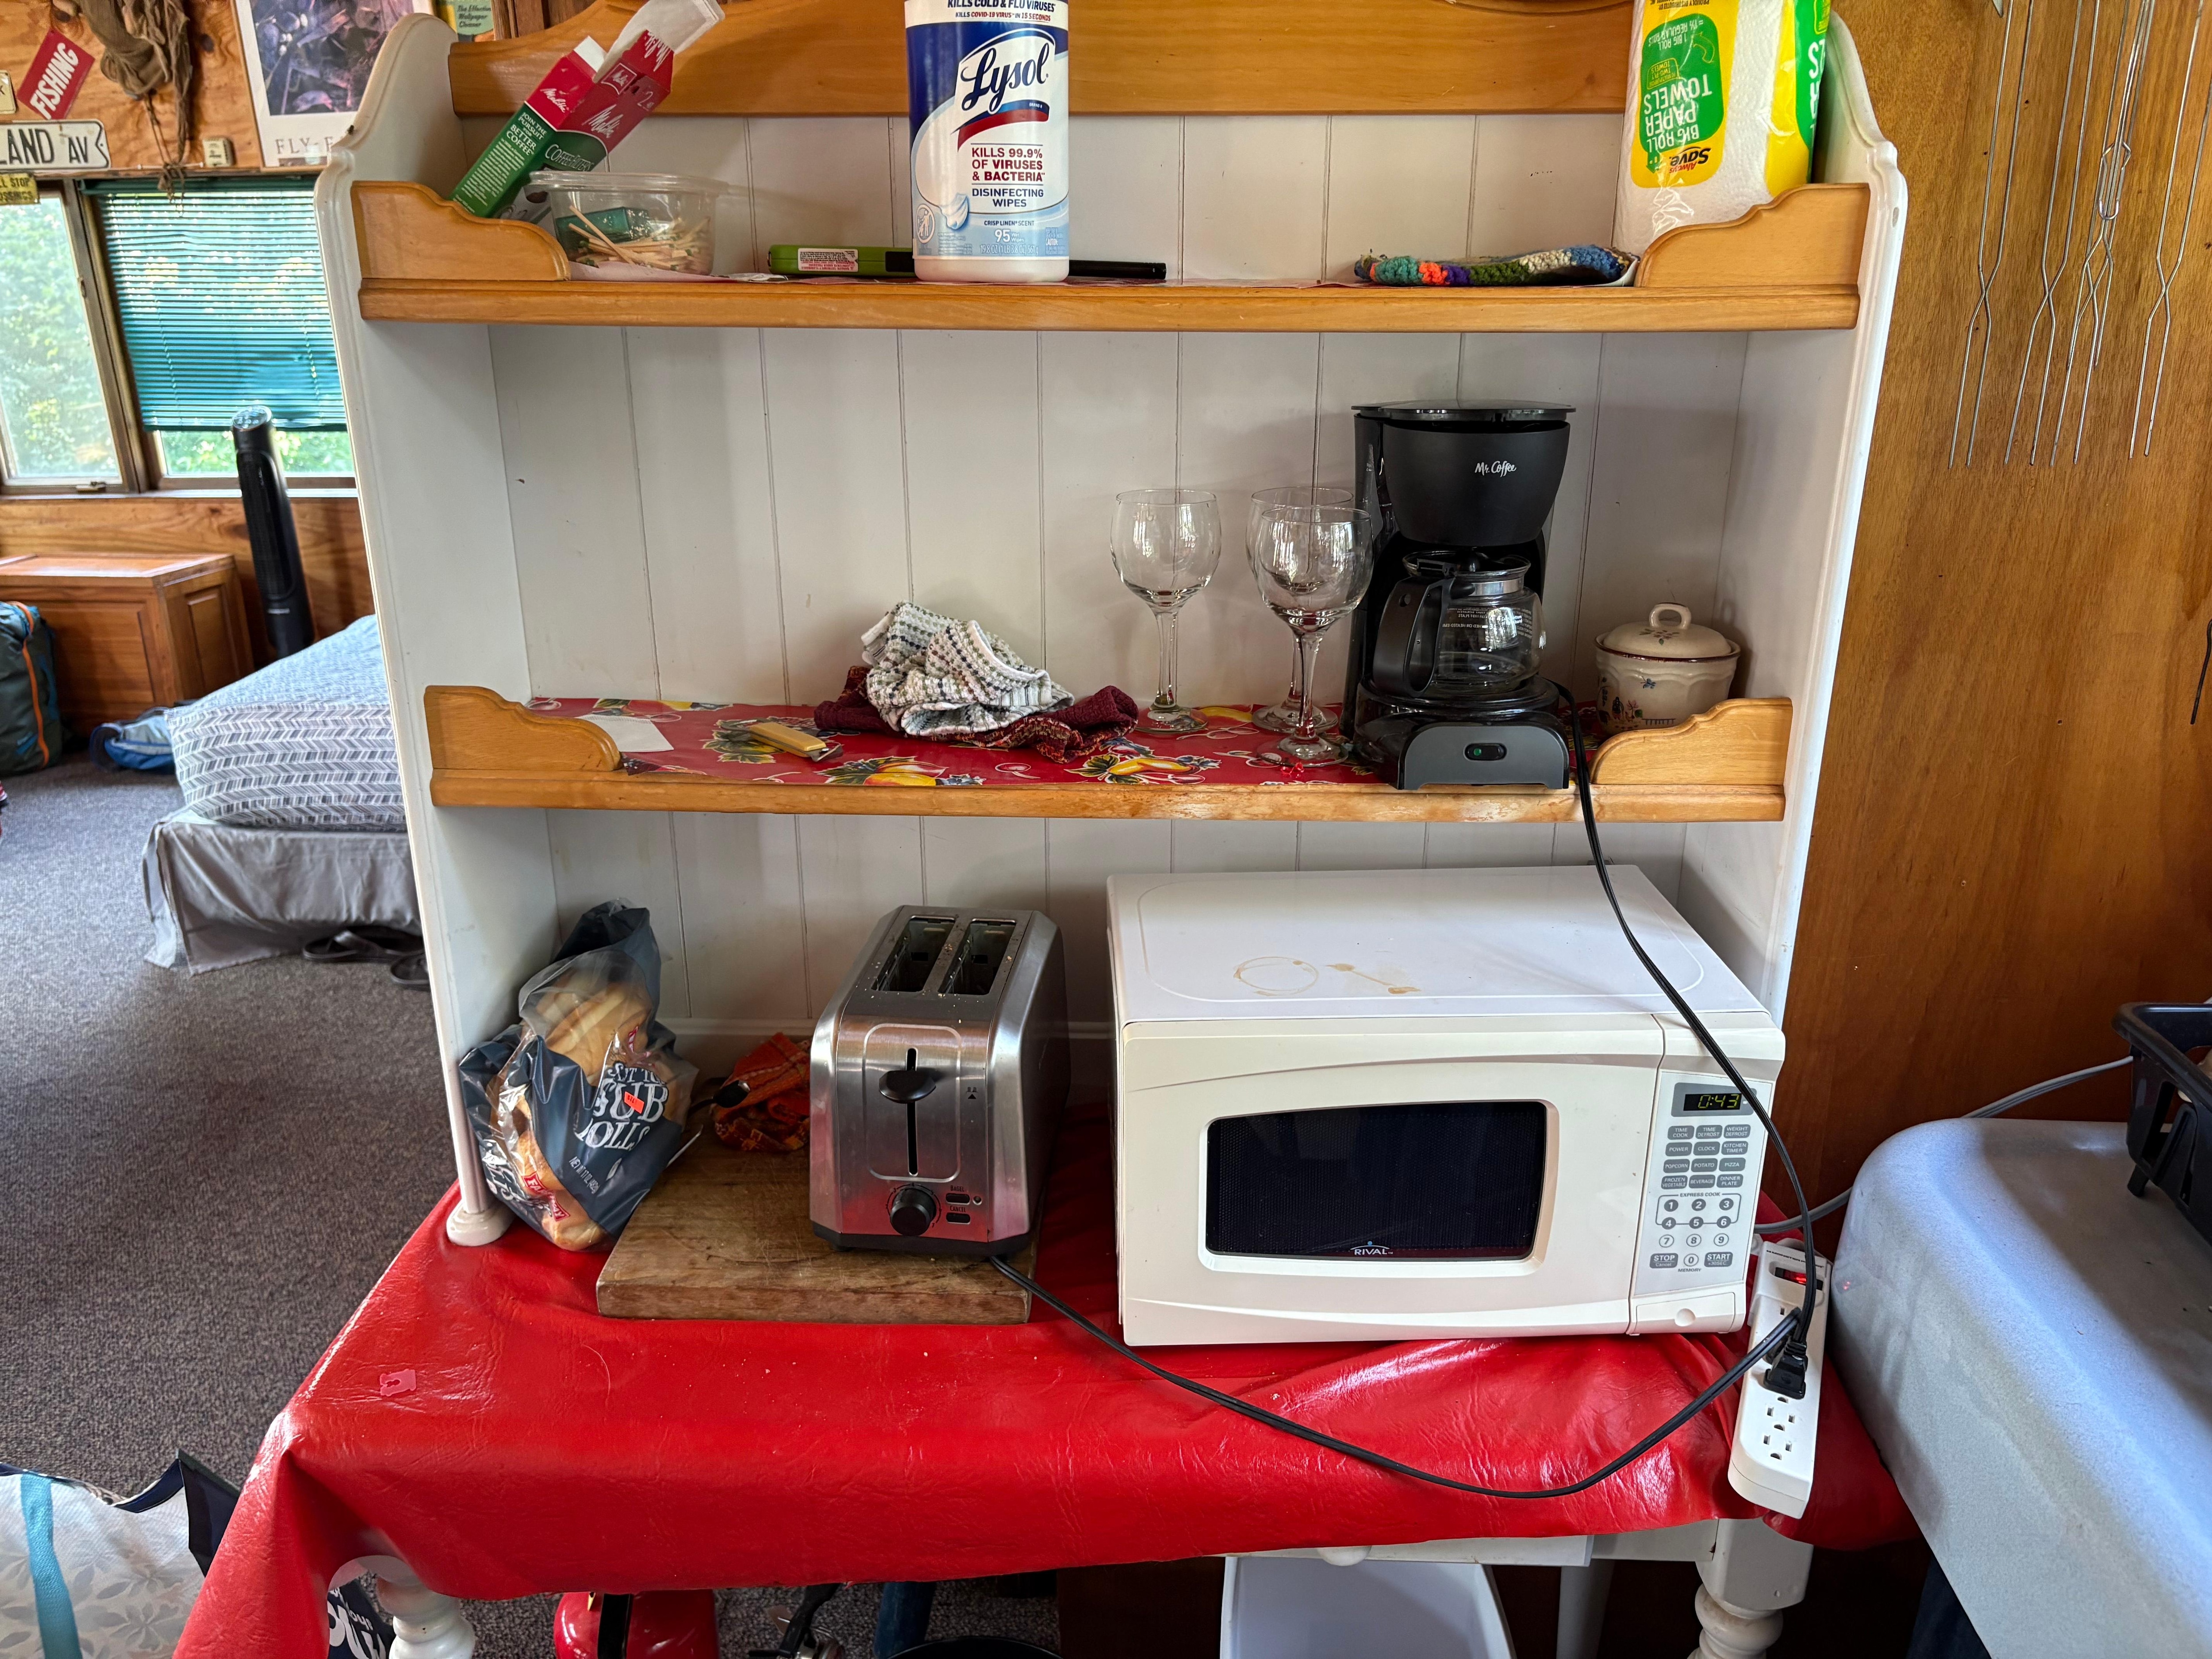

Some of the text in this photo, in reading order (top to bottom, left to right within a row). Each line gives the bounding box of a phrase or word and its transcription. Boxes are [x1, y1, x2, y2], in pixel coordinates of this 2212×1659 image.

[1008, 0, 1025, 8] FLU
[1661, 22, 1688, 39] REGULAR
[1658, 38, 1671, 50] ROLL
[1674, 36, 1682, 46] BIG
[30, 43, 78, 119] FISHING
[960, 42, 1046, 112] Lysol
[1644, 74, 1713, 115] TOWELS
[522, 112, 547, 136] JOIN THE
[1645, 100, 1697, 137] PAPER
[518, 116, 544, 140] PURSUIT
[511, 124, 537, 151] BETTER
[1647, 124, 1699, 153] BIG ROLL
[0, 128, 88, 165] AND AV
[972, 148, 1043, 159] KILLS 99.9%
[972, 159, 1043, 170] OF VIRUSES
[1669, 161, 1697, 173] Always
[10, 177, 30, 187] STOP
[972, 171, 980, 181] &
[972, 188, 1044, 197] DISINFECTING
[995, 229, 1010, 242] 95
[980, 245, 991, 254] 19.8
[991, 245, 998, 254] OZ
[1004, 245, 1010, 254] LB
[1475, 461, 1517, 477] Mr. Coffee
[593, 1078, 668, 1123] SUB
[1698, 1094, 1740, 1109] 0:43
